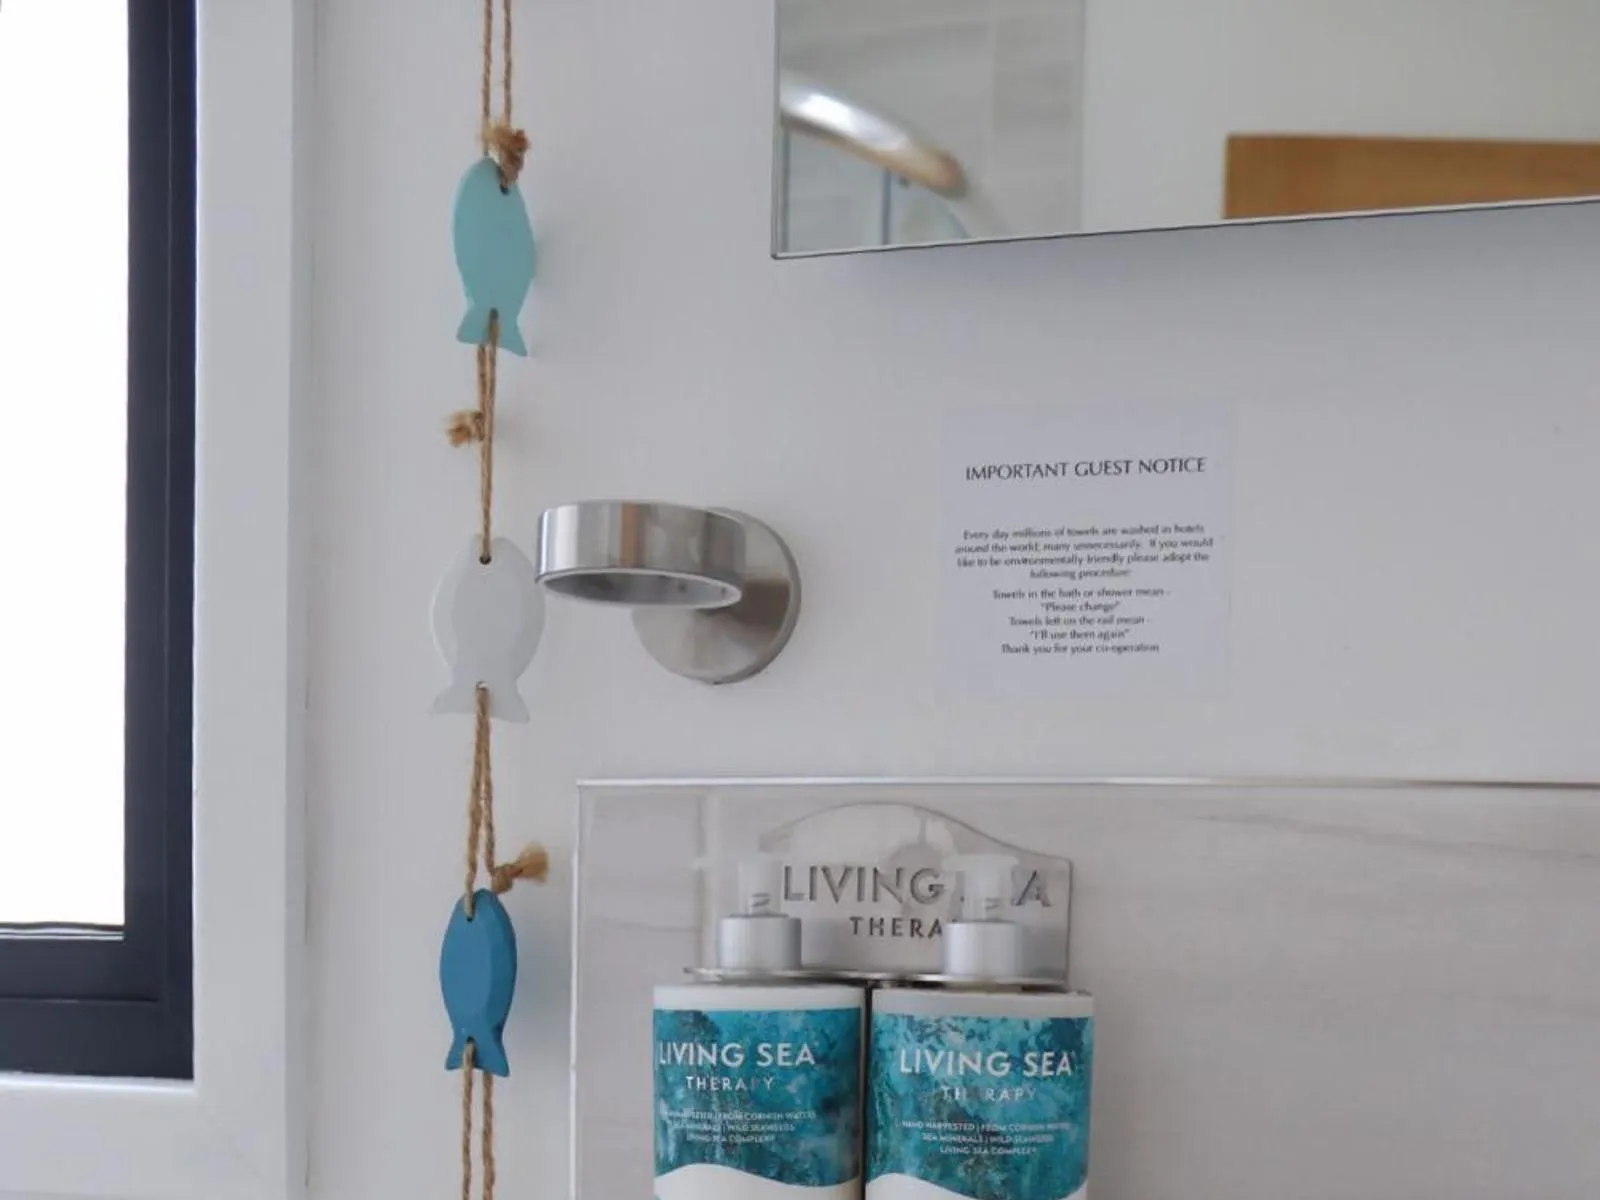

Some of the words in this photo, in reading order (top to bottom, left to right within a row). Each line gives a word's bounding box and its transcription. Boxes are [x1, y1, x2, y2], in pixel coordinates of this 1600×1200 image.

[965, 462, 1070, 481] IMPORTANT
[1074, 459, 1133, 477] GUEST
[1138, 457, 1207, 475] NOTICE
[963, 529, 989, 541] Every
[991, 528, 1009, 541] day
[1011, 527, 1052, 538] millions
[1054, 526, 1066, 537] of
[1066, 526, 1099, 536] towels
[1102, 527, 1118, 535] are
[1121, 524, 1160, 535] washed
[1161, 525, 1172, 534] in
[1173, 523, 1205, 534] hotels
[955, 543, 990, 554] around
[991, 541, 1008, 552] the
[1043, 541, 1070, 553] many
[1158, 540, 1178, 552] you
[1179, 537, 1214, 548] would
[957, 556, 976, 568] like
[976, 557, 988, 568] to
[989, 555, 1001, 567] be
[1003, 553, 1084, 567] environmentally
[1086, 553, 1125, 566] friendly
[1126, 551, 1159, 566] please
[1161, 551, 1191, 564] adopt
[1193, 551, 1210, 562] the
[1030, 567, 1076, 581] following
[992, 587, 1026, 600] Towels
[1027, 588, 1038, 599] in
[1040, 587, 1056, 598] the
[1058, 586, 1081, 598] bath
[1082, 589, 1094, 598] or
[1096, 585, 1133, 597] shower
[1135, 587, 1165, 597] mean
[1008, 615, 1043, 627] Towels
[1044, 615, 1061, 626] left
[1063, 616, 1077, 626] on
[1078, 614, 1096, 626] the
[1096, 614, 1115, 626] rail
[1116, 615, 1146, 626] mean
[1050, 631, 1067, 640] use
[1069, 628, 1096, 640] them
[1001, 643, 1030, 655] Thank
[1032, 645, 1052, 656] you
[1053, 642, 1068, 653] for
[1069, 643, 1094, 655] your
[783, 865, 946, 906] LIVING
[849, 915, 959, 940] THERA
[659, 1040, 746, 1068] LIVING
[755, 1042, 816, 1067] SEA
[899, 1047, 1012, 1077] LIVING
[1022, 1051, 1073, 1077] SEA
[940, 1085, 1037, 1102] THRAPY
